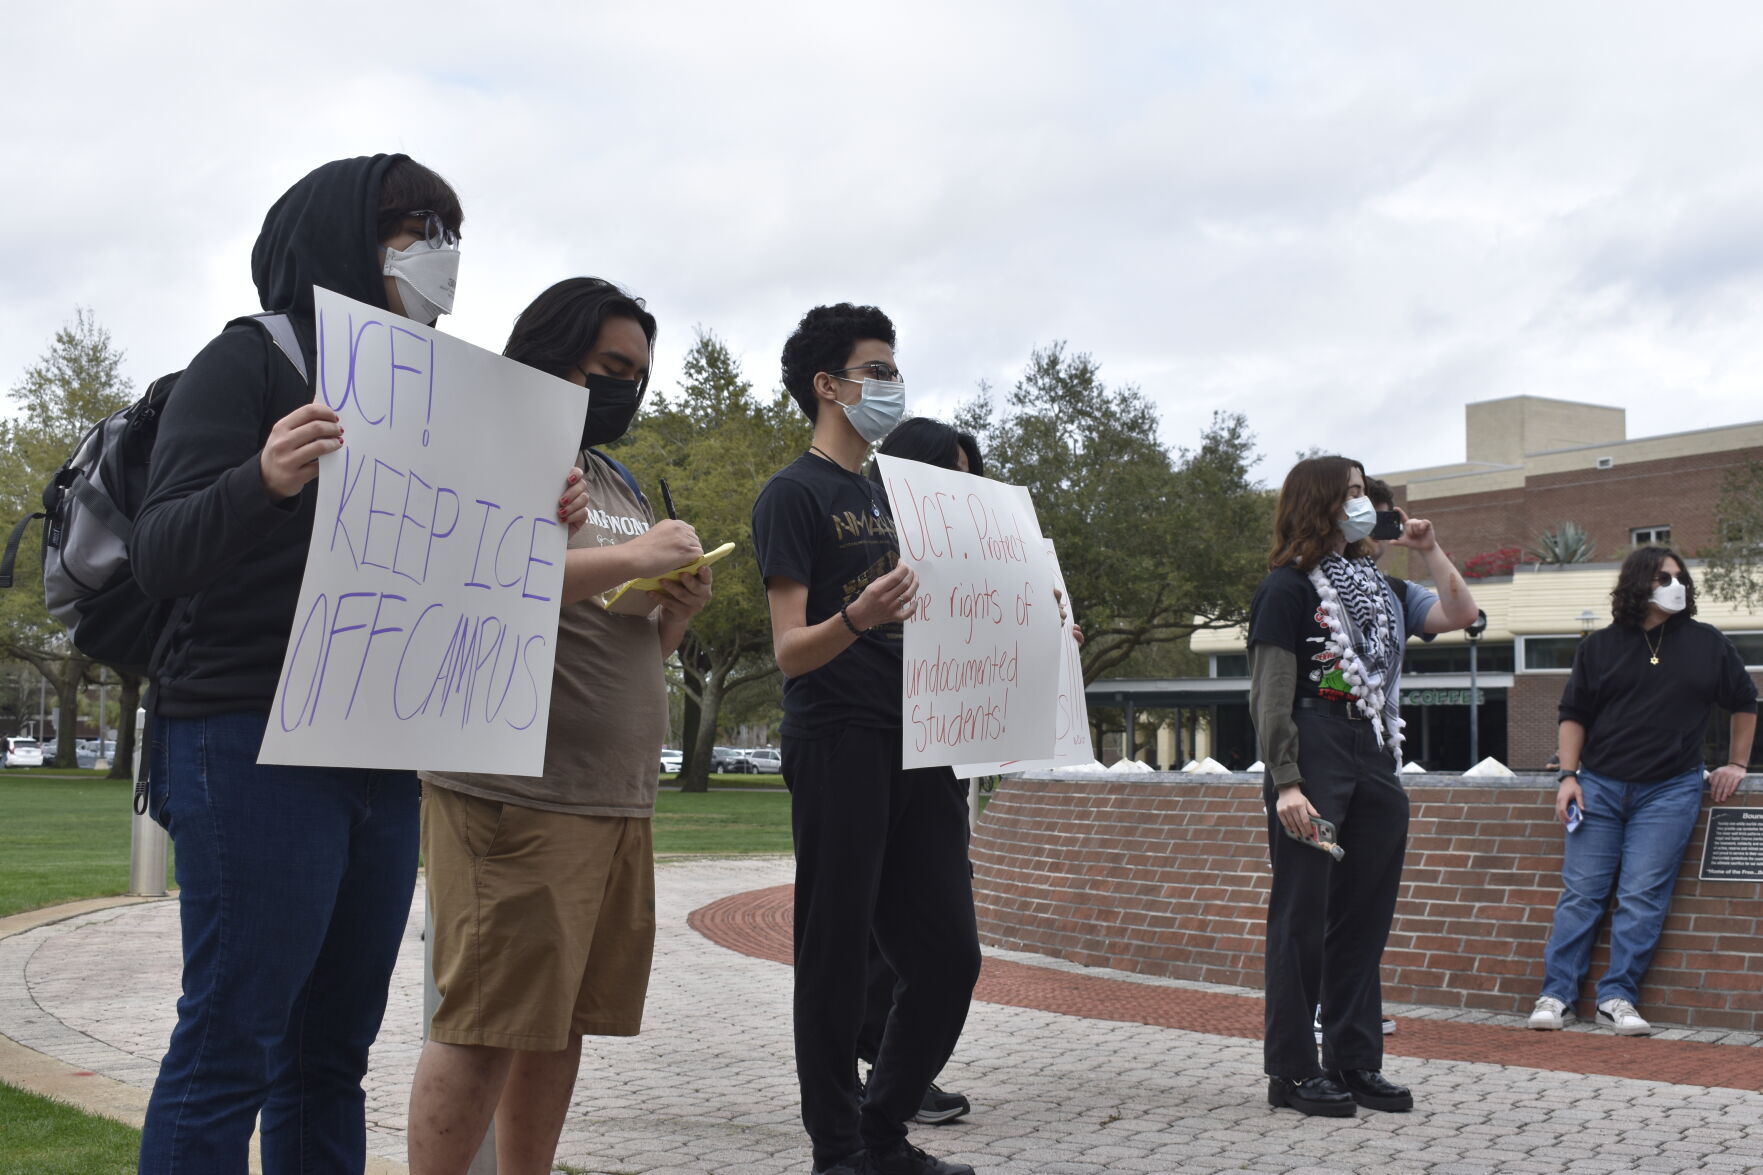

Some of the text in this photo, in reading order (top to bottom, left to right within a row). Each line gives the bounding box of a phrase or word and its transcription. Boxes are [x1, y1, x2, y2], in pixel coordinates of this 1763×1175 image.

[319, 307, 434, 447] UCF!
[331, 446, 557, 602] KEEP ICE
[966, 493, 1026, 563] Protect
[281, 592, 546, 732] OFF CAMPUS
[909, 593, 932, 624] he
[950, 578, 1002, 644] rights
[1016, 582, 1034, 627] of
